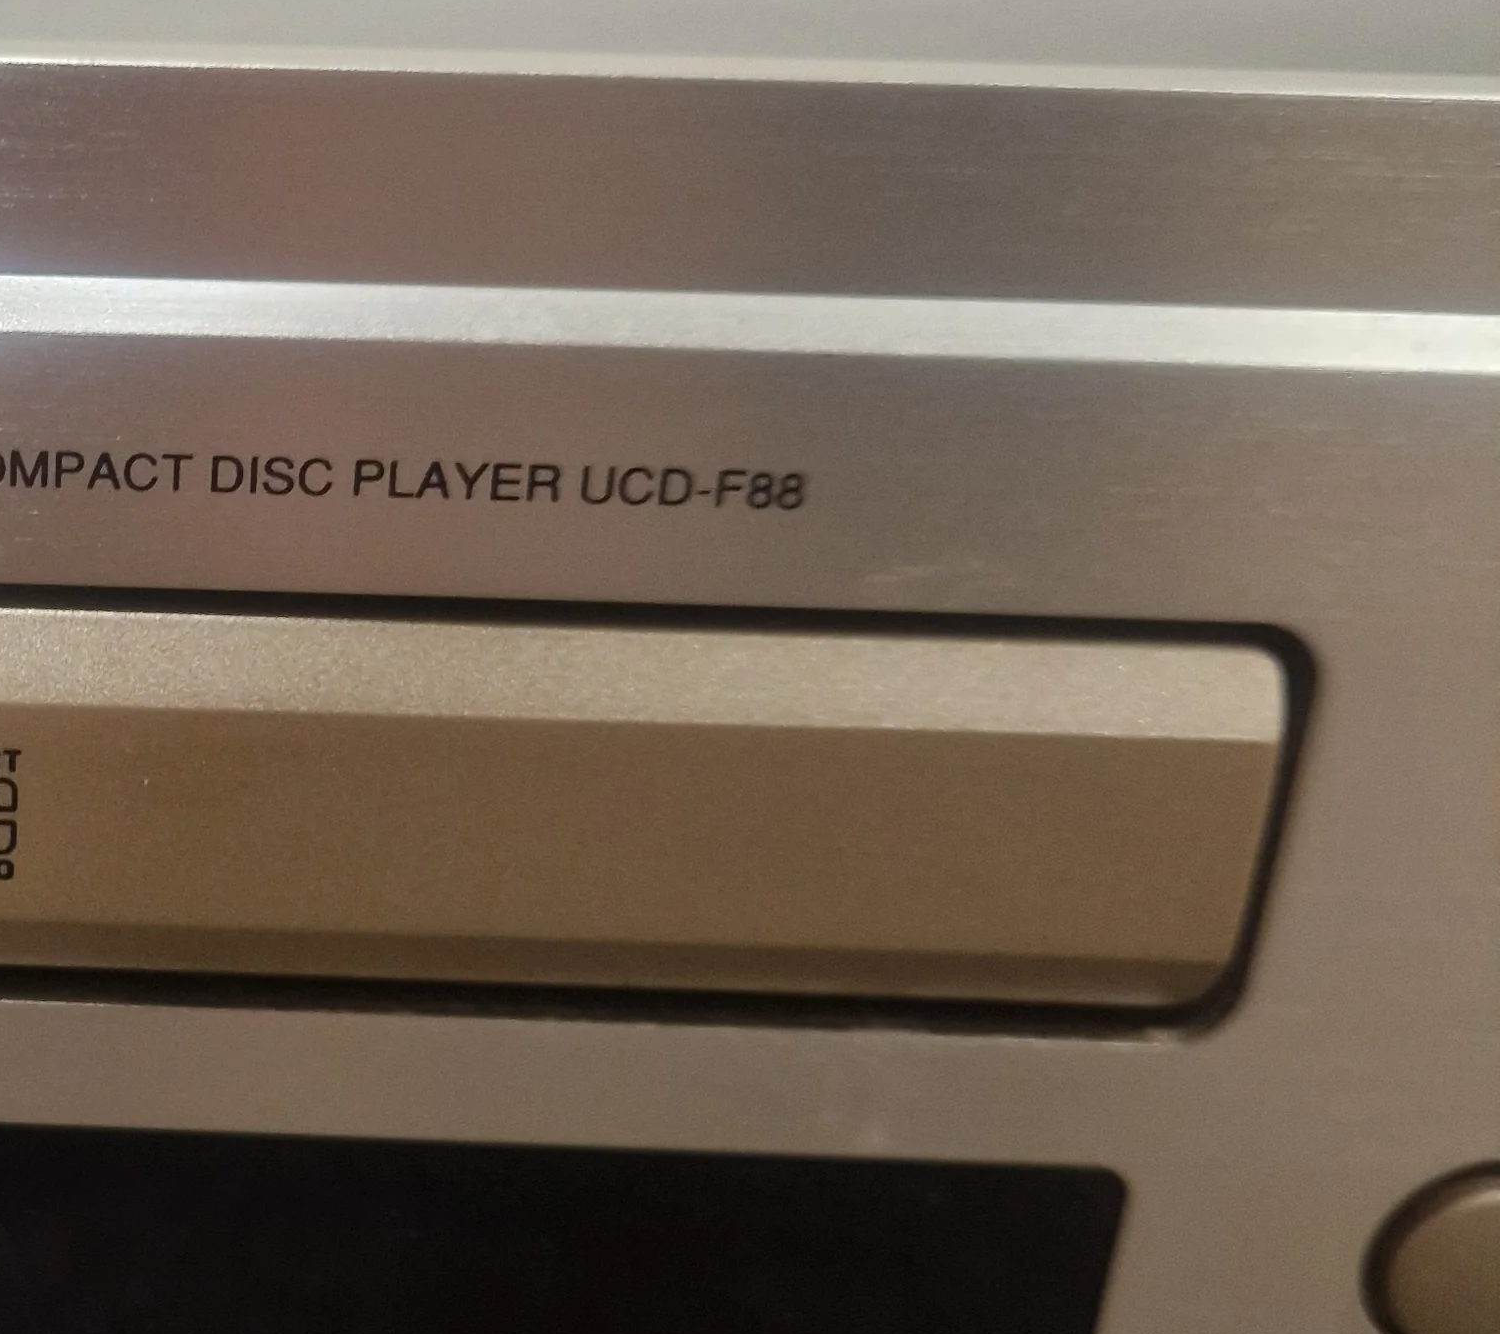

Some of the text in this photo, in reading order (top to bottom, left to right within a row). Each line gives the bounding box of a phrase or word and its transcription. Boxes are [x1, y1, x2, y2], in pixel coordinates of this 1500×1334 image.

[209, 454, 335, 498] DISC
[352, 458, 562, 504] PLAYER
[581, 465, 807, 512] UCD-F88
